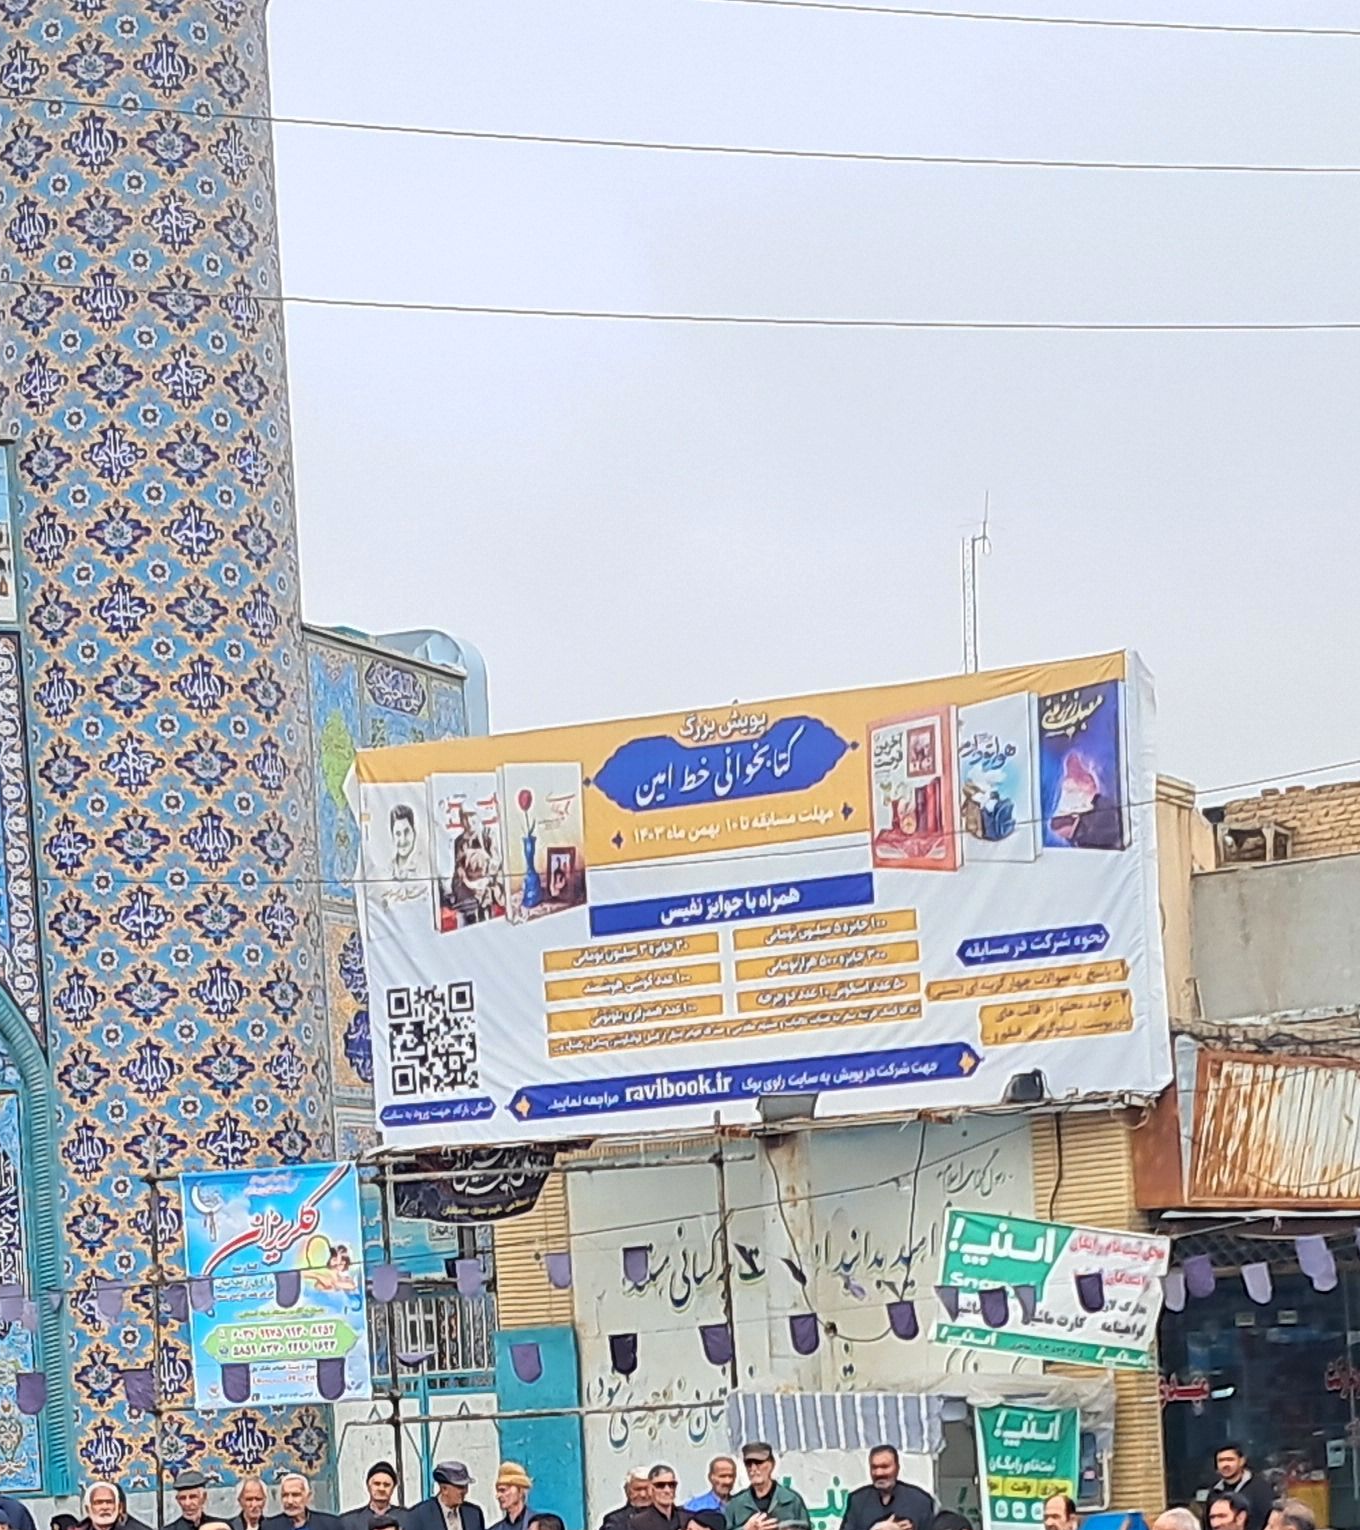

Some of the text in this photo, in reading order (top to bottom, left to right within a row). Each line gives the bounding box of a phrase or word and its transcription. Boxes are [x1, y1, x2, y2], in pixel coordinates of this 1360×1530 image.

[679, 709, 768, 741] پویش بزرگ
[634, 724, 805, 807] کتابخوانی خط امین
[740, 813, 750, 830] تا
[752, 812, 796, 830] مسابقه
[798, 805, 834, 823] مهلت
[634, 827, 665, 844] ۱۴۰۳
[667, 826, 686, 841] ماه
[689, 823, 720, 842] بهمن
[660, 887, 801, 926] همراه با جوایز نفیس
[799, 923, 832, 940] میلیون
[842, 918, 868, 936] جایزه
[765, 928, 797, 945] تومانی
[606, 945, 639, 962] میلیون
[964, 930, 1106, 963] نحوه شرکت در مسابقه
[573, 950, 604, 967] تومانی
[840, 951, 866, 967] جایزه
[583, 981, 624, 996] هوشمند
[833, 1067, 865, 1085] پویش
[865, 1067, 876, 1081] در
[877, 1063, 910, 1079] شرکت
[911, 1061, 939, 1076] جهت
[625, 1071, 733, 1103] ravibook.ir
[763, 1074, 786, 1092] راوی
[788, 1072, 818, 1089] سایت
[820, 1073, 831, 1087] به
[583, 1090, 620, 1110] مراجعه
[202, 1162, 351, 1274] گلریزان
[949, 1217, 1056, 1266] اسنپ!
[1056, 1315, 1087, 1332] کارت
[993, 1410, 1061, 1447] اسنپ!
[989, 1455, 1023, 1474] رایگان
